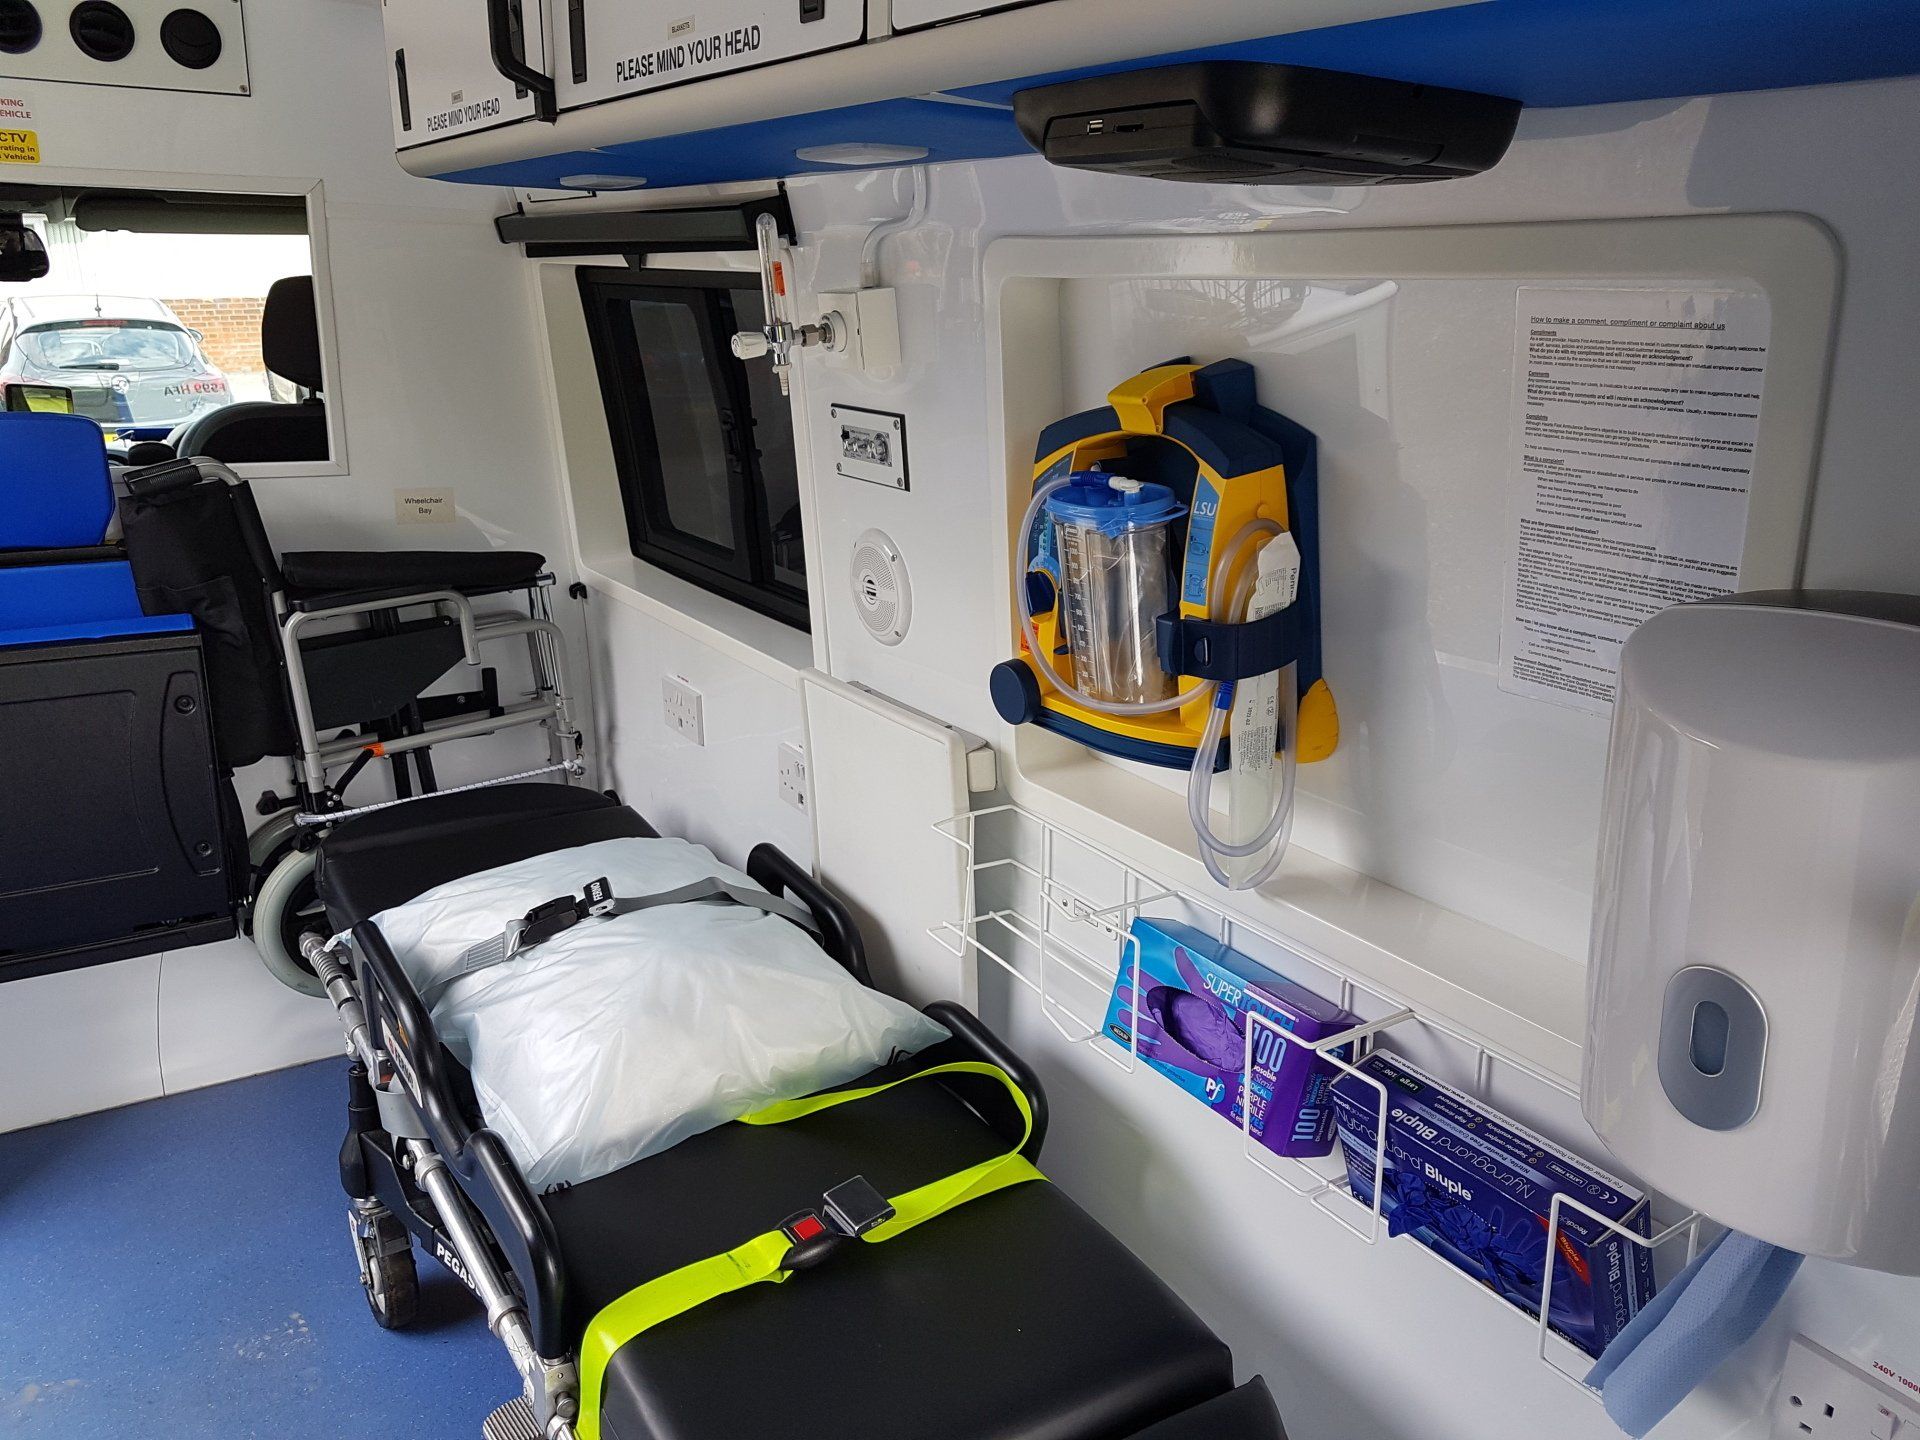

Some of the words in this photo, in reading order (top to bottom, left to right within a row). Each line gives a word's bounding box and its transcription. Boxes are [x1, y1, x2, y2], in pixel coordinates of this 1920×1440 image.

[616, 52, 653, 82] PLEASE
[657, 44, 684, 72] MIND
[687, 34, 721, 66] YOUR
[725, 24, 760, 56] HEAD
[427, 112, 447, 132] PLEASE
[448, 108, 462, 127] MIND
[463, 102, 481, 122] YOUR
[482, 97, 499, 117] HEAD
[1530, 315, 1543, 324] How
[1545, 316, 1551, 324] to
[1553, 316, 1569, 325] make
[1571, 317, 1575, 325] a
[1609, 318, 1647, 328] compliment
[1649, 319, 1656, 328] or
[1658, 320, 1692, 329] complaint
[1694, 321, 1714, 330] about
[1716, 322, 1725, 331] us
[1194, 501, 1217, 516] LSU
[1204, 973, 1242, 1007] SUPER
[1252, 1023, 1287, 1072] 100
[1252, 1064, 1276, 1082] posable
[1254, 1074, 1275, 1092] Sterile
[1398, 1076, 1420, 1090] Large
[1236, 1095, 1265, 1120] NIRILE
[1238, 1085, 1267, 1110] PRPLE
[1232, 1104, 1264, 1130] GLVES
[1291, 1108, 1320, 1142] 100
[1392, 1108, 1437, 1141] Bluple
[1335, 1106, 1422, 1173] Nytrauard
[1425, 1162, 1473, 1201] Bluple
[1468, 1135, 1485, 1146] Free
[1434, 1133, 1539, 1199] Nytraguard
[1606, 1242, 1622, 1282] Bluple
[1872, 1361, 1896, 1377] 240V
[1898, 1376, 1920, 1394] 1000
